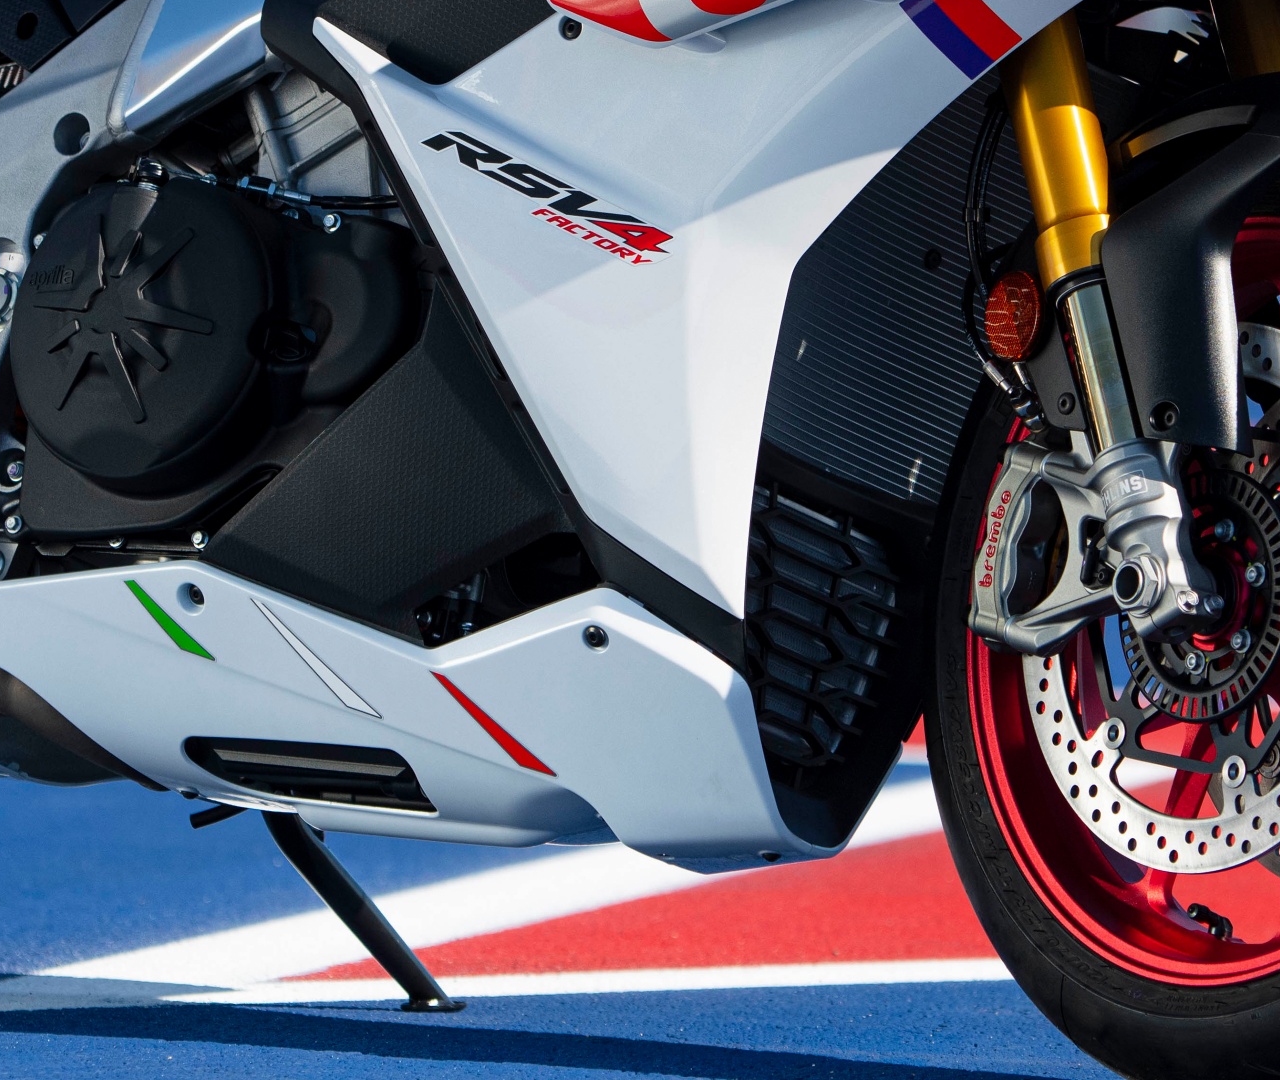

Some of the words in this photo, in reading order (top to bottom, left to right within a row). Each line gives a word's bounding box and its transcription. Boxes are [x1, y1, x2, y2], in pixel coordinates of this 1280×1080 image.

[421, 131, 673, 253] RSV4
[531, 208, 653, 264] FACTORY
[30, 264, 74, 290] aprilia
[1102, 476, 1142, 508] HLINS
[979, 491, 1011, 587] brembo
